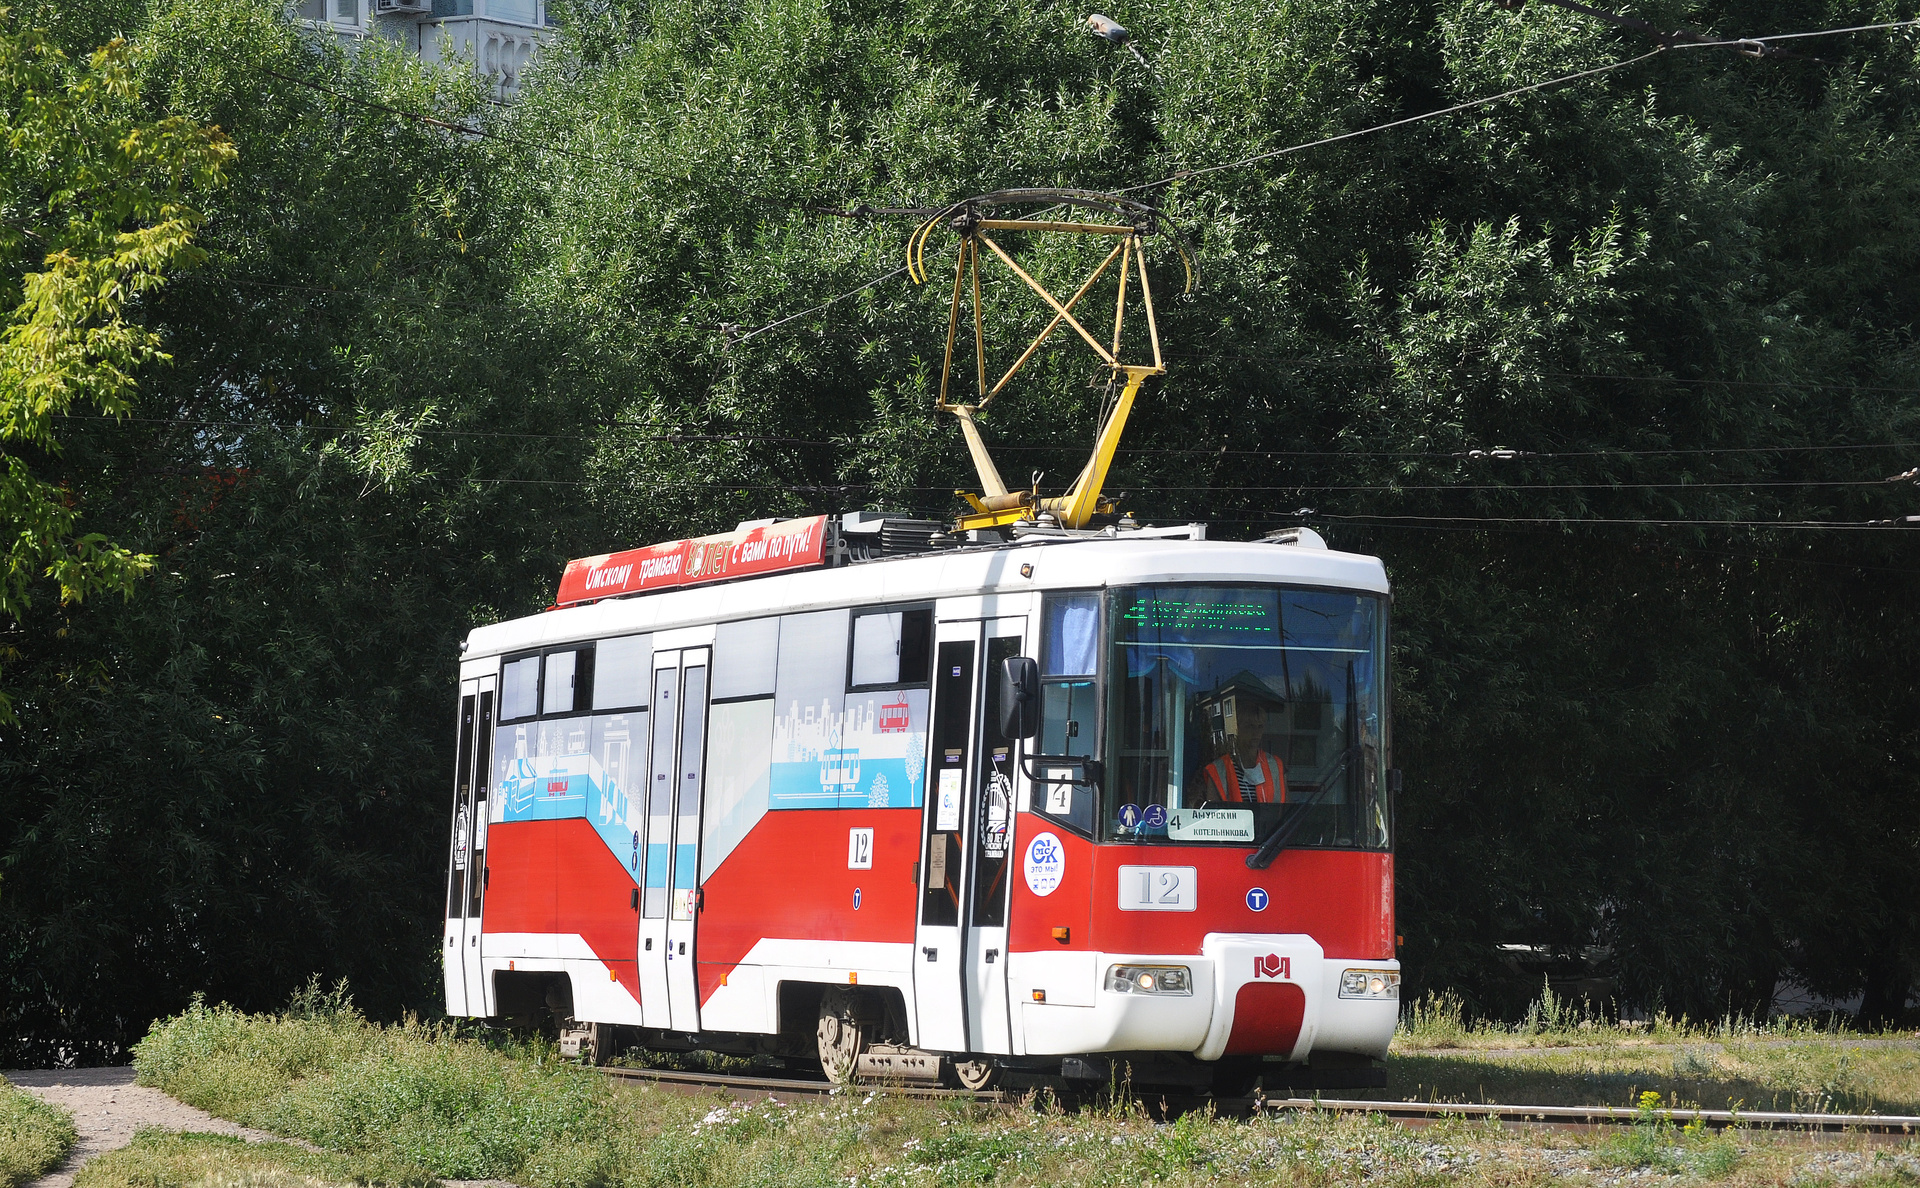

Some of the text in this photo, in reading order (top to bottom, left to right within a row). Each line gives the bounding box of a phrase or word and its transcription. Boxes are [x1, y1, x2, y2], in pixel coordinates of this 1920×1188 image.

[585, 563, 634, 590] Омскому
[639, 554, 681, 585] трамваю
[741, 539, 769, 563] вами
[768, 536, 783, 559] по
[782, 523, 814, 562] пути!
[1170, 815, 1181, 831] 4
[854, 833, 869, 864] 12
[1138, 872, 1180, 904] 12
[1251, 892, 1264, 909] Т
